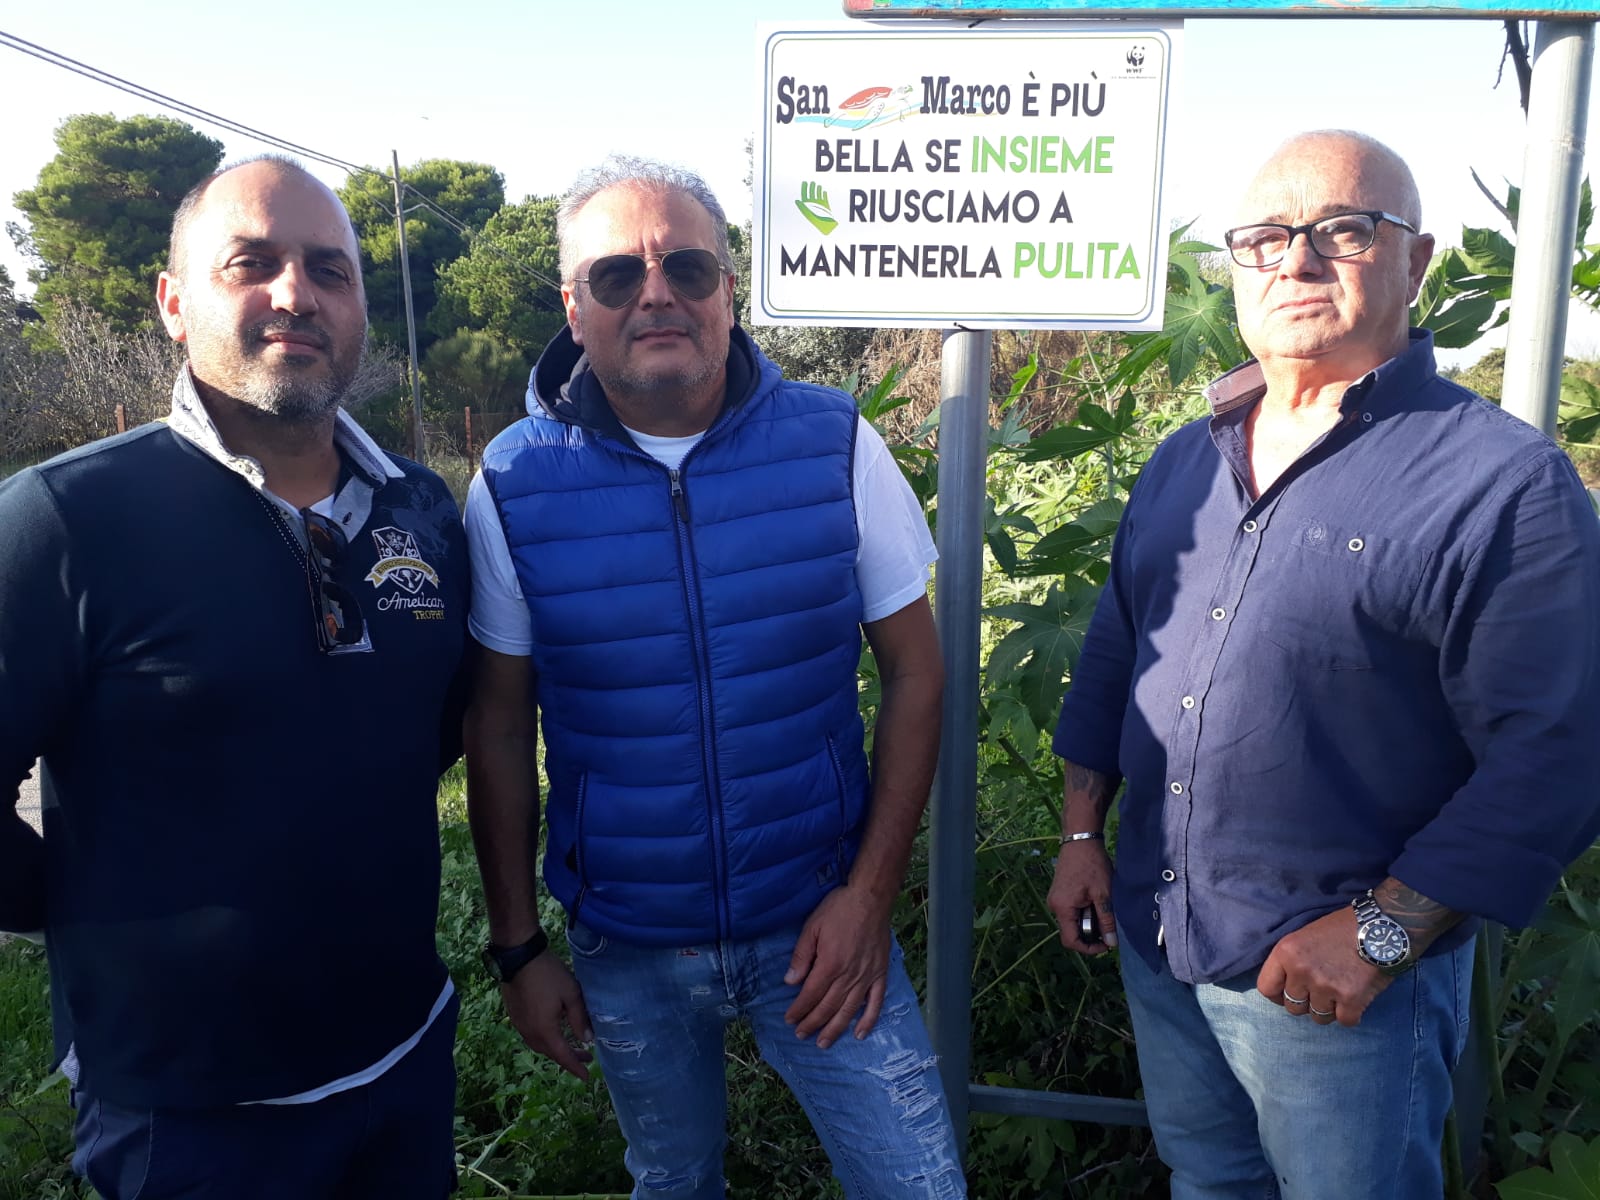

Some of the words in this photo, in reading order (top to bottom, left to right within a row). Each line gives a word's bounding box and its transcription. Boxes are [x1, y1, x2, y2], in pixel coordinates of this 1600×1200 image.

[776, 76, 830, 124] San
[919, 76, 1011, 116] Marco
[1022, 71, 1041, 117] È
[1050, 71, 1106, 117] PIÙ
[815, 139, 914, 173] BELLA
[924, 139, 962, 172] SE
[971, 135, 1115, 173] INSIEME
[848, 188, 1040, 224] RIUSCIAMO
[1049, 190, 1073, 224] A
[780, 244, 1002, 279] MANTENERLA
[1013, 241, 1141, 280] PULITA
[381, 548, 392, 557] 19
[406, 548, 418, 558] 82
